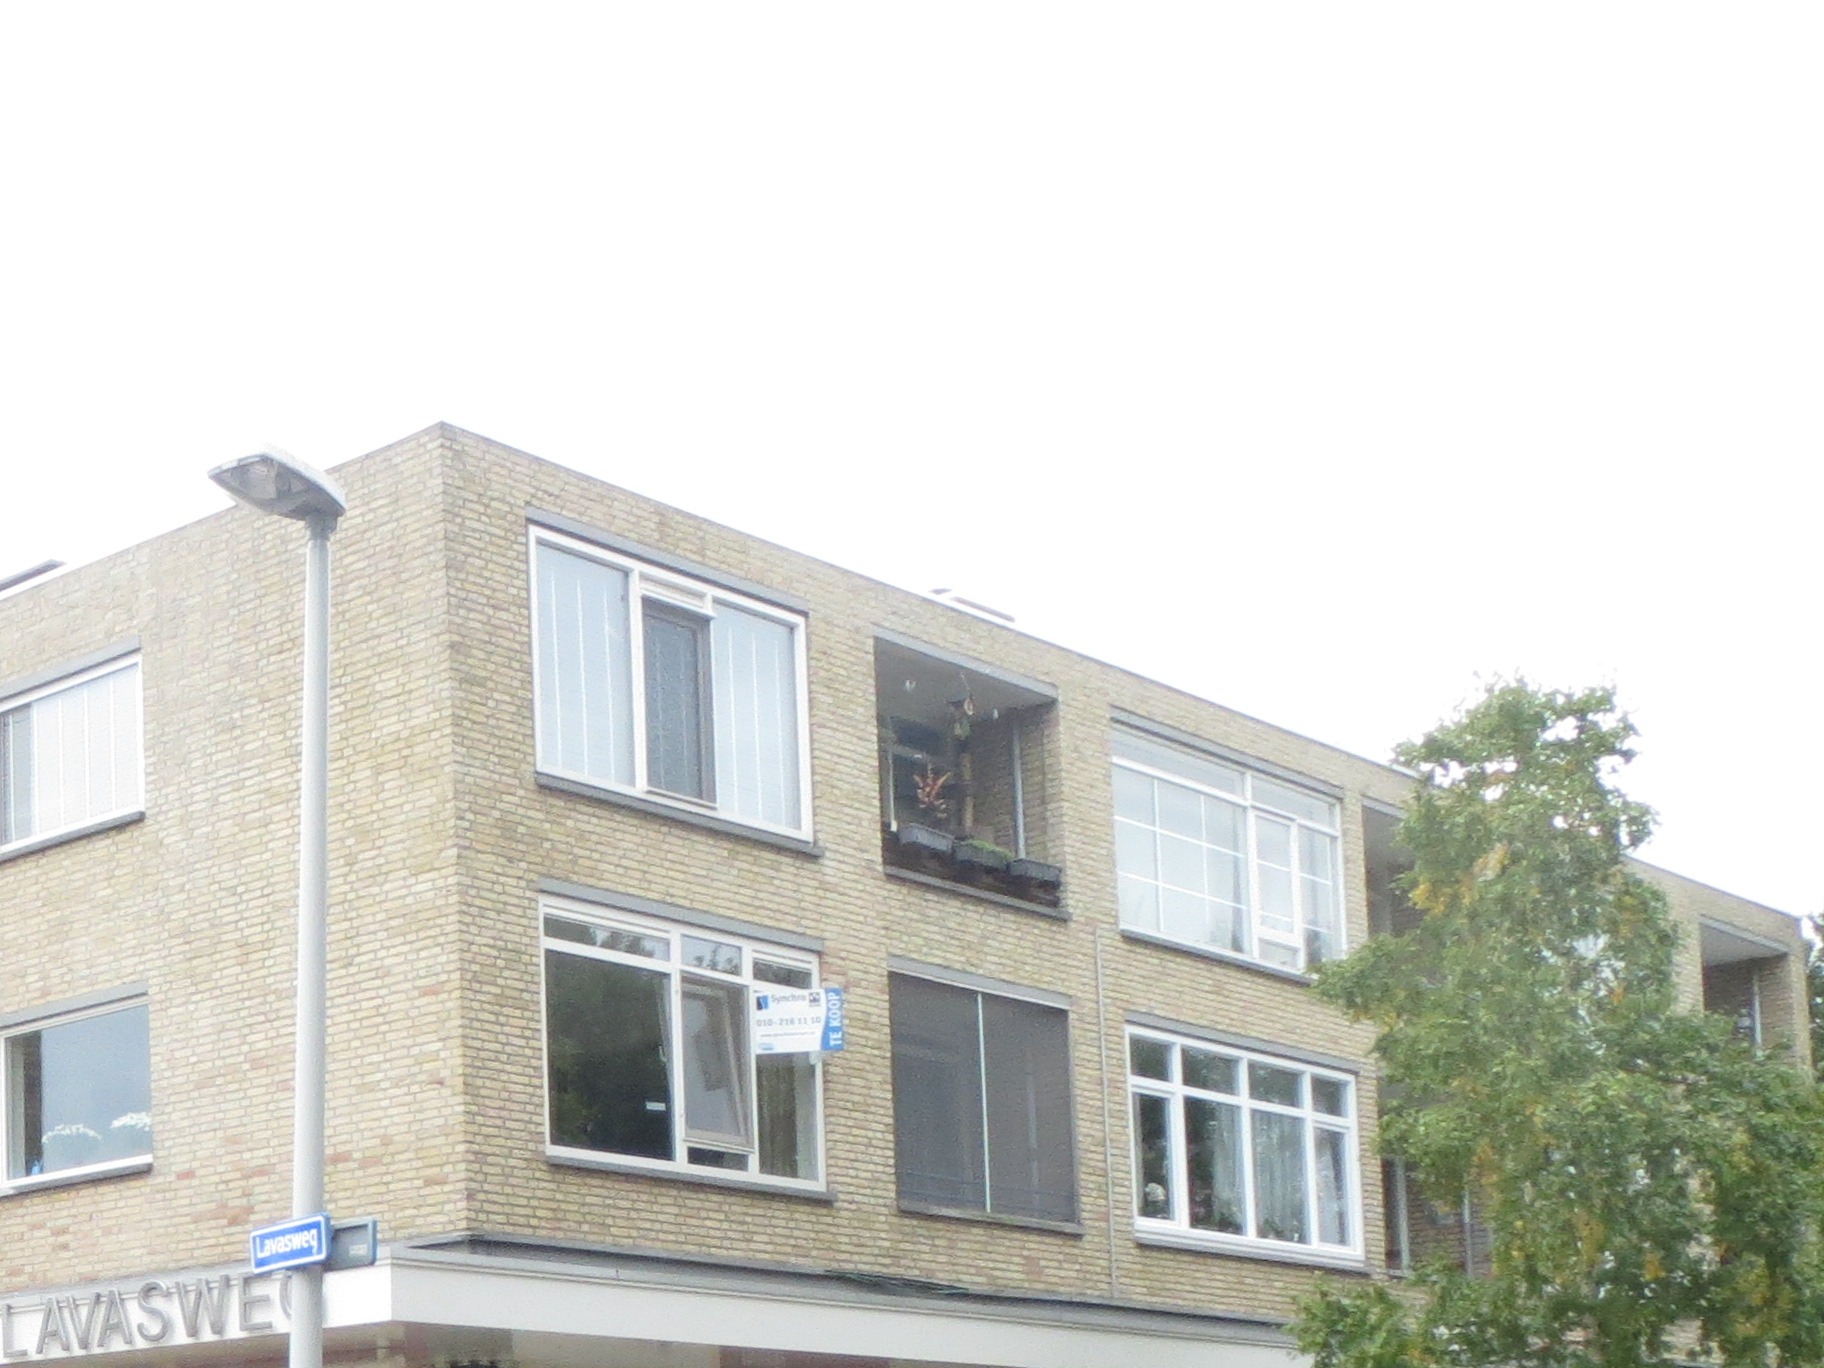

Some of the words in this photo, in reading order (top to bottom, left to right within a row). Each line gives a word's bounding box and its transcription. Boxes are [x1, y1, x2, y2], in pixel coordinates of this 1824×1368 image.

[827, 992, 842, 1027] KOOP
[829, 1031, 842, 1046] TE
[255, 1228, 319, 1259] Lavasweg
